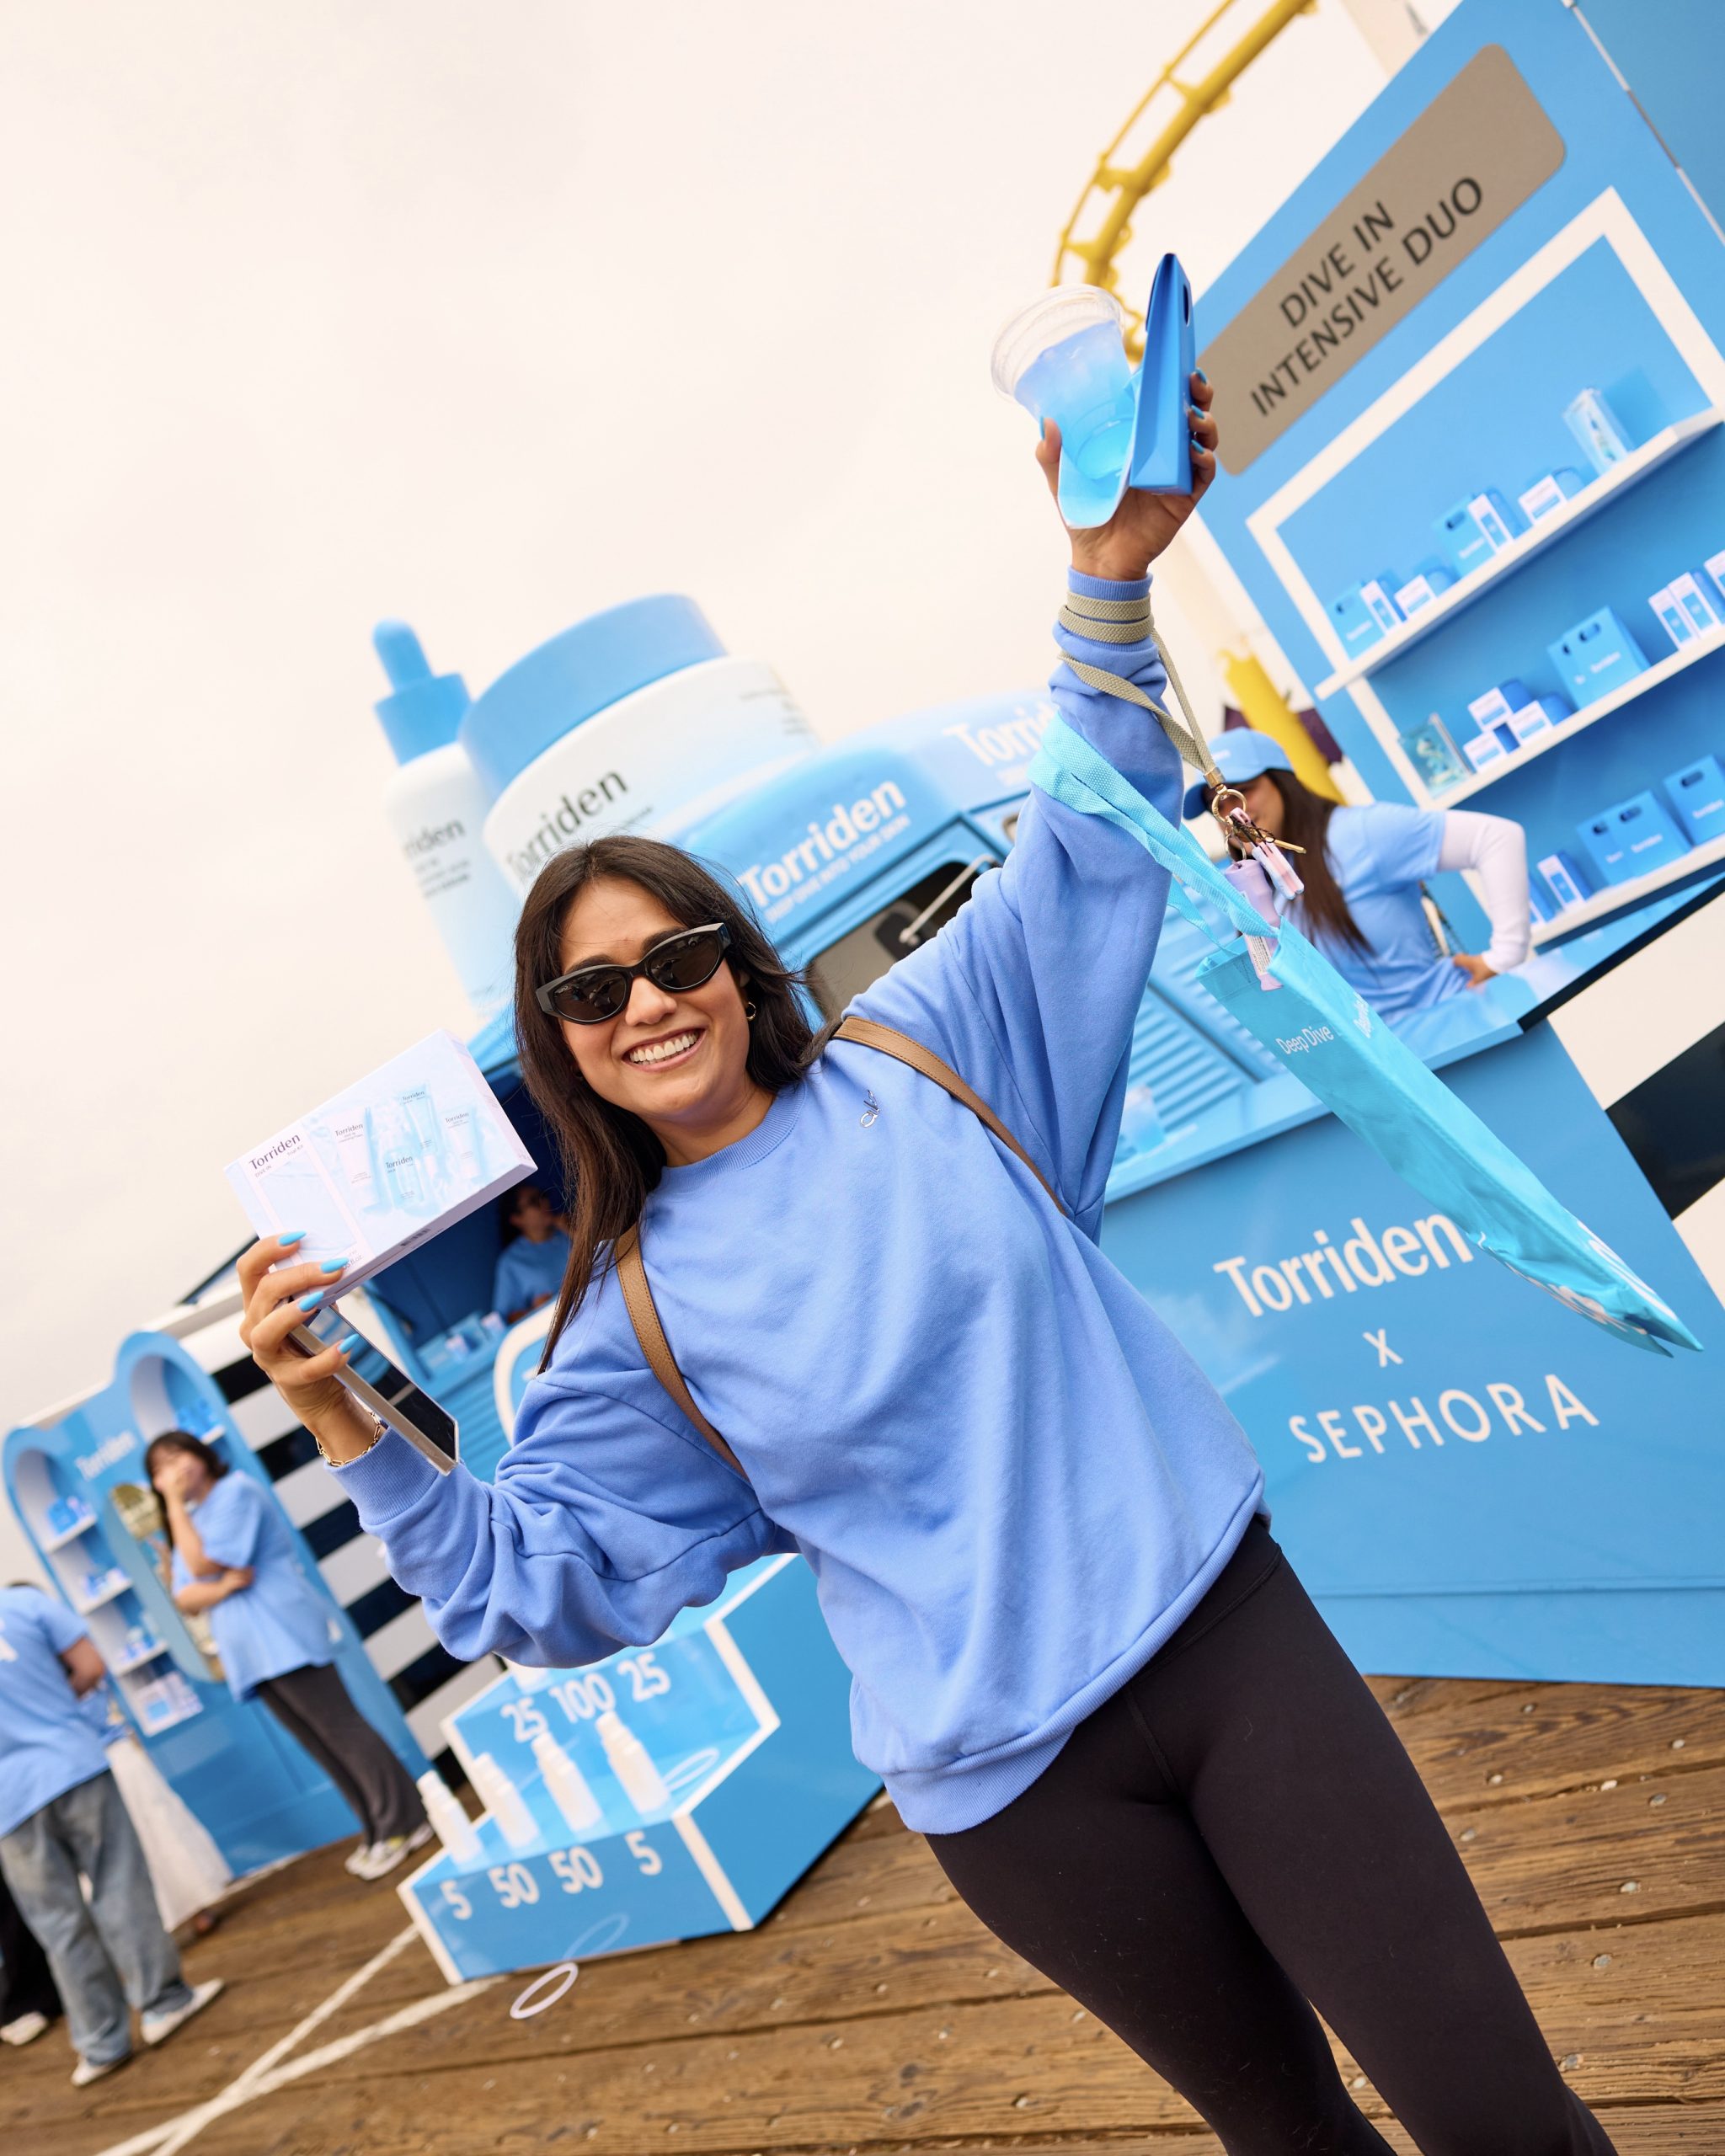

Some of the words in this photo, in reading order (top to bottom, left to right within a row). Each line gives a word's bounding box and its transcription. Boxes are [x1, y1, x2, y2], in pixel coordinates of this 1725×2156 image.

[1249, 256, 1405, 418] INTENSIVE
[1401, 177, 1482, 266] DUO
[1279, 243, 1355, 329] DIVE
[1352, 200, 1395, 253] IN
[735, 780, 906, 908] Torriden
[1275, 1036, 1309, 1054] Deep
[1301, 1026, 1334, 1046] Dive
[248, 1134, 301, 1170] Torriden
[335, 1123, 363, 1137] Torriden
[386, 1156, 413, 1169] Torriden
[1213, 1214, 1474, 1318] Torriden
[1289, 1374, 1599, 1463] SEPHORA
[499, 1696, 548, 1743] 25
[548, 1673, 616, 1724] 100
[617, 1652, 671, 1703] 25
[440, 1879, 473, 1921] 5
[487, 1862, 540, 1908] 50
[548, 1845, 604, 1894] 50
[625, 1830, 663, 1876] 5
